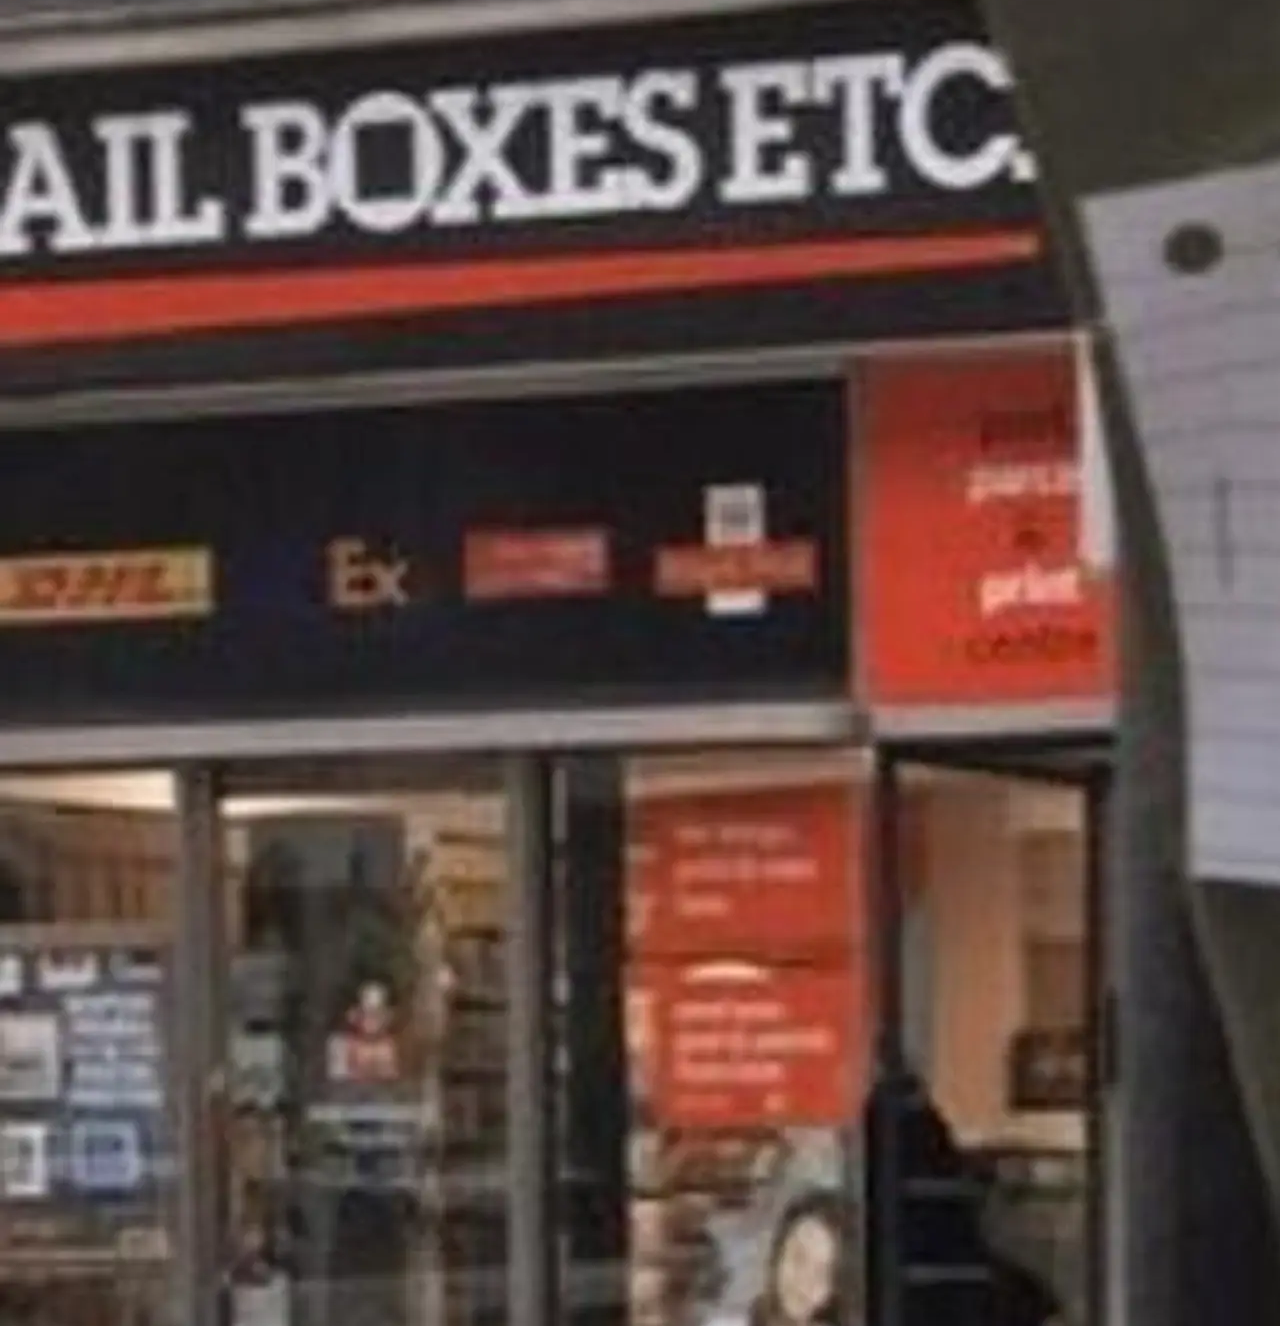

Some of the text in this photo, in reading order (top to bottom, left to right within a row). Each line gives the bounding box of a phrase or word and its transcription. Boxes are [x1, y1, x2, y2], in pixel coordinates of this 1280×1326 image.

[0, 42, 1039, 255] AIL BOXES ETC.
